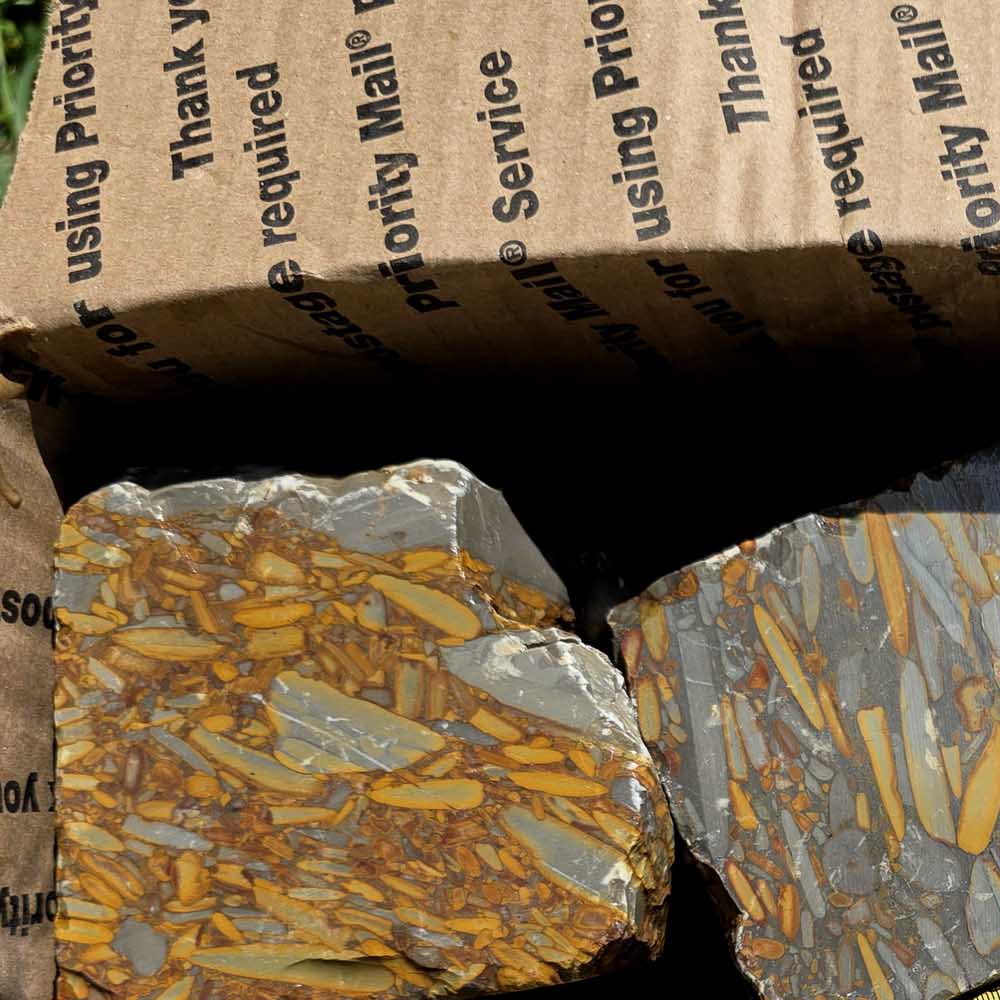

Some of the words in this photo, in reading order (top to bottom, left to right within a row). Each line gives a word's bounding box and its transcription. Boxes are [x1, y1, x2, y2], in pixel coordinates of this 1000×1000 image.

[163, 38, 214, 181] Thank
[584, 0, 640, 99] Prio
[779, 28, 871, 217] required
[235, 61, 301, 247] required
[477, 48, 540, 224] Service
[611, 106, 671, 241] using
[55, 159, 110, 284] using
[368, 152, 461, 313] Priority
